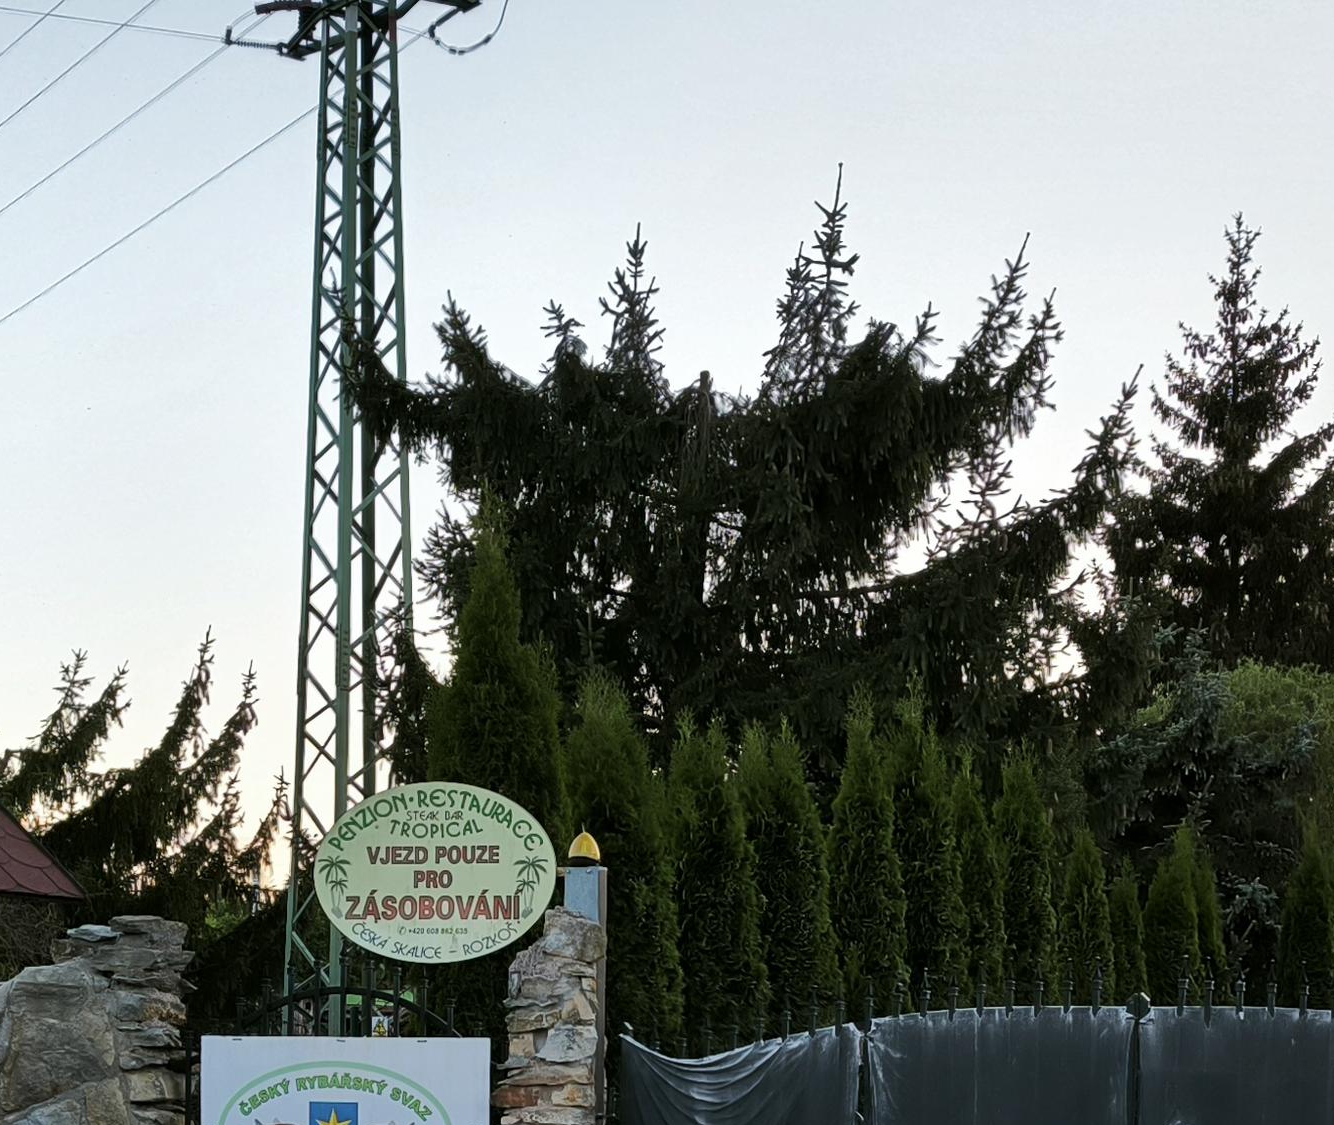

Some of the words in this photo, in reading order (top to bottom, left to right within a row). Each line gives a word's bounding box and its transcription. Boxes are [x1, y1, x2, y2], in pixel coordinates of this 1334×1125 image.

[328, 792, 408, 851] PENZION
[418, 789, 544, 851] RESTAURACE
[406, 810, 439, 821] STEAK
[445, 811, 464, 821] BAR
[390, 819, 483, 839] TROPICAL
[367, 846, 429, 865] VJEZD
[435, 845, 500, 864] POUZE
[413, 870, 453, 888] PRO
[345, 889, 522, 921] ZÁSOBOVÁNÍ
[352, 921, 391, 949] ČESKÁ
[393, 941, 442, 959] SKALICE
[463, 921, 518, 956] ROZKOŠ
[239, 1078, 290, 1116] ČESKÝ
[296, 1072, 388, 1096] RYBÁŘSKÝ
[390, 1087, 433, 1122] SVAZ
